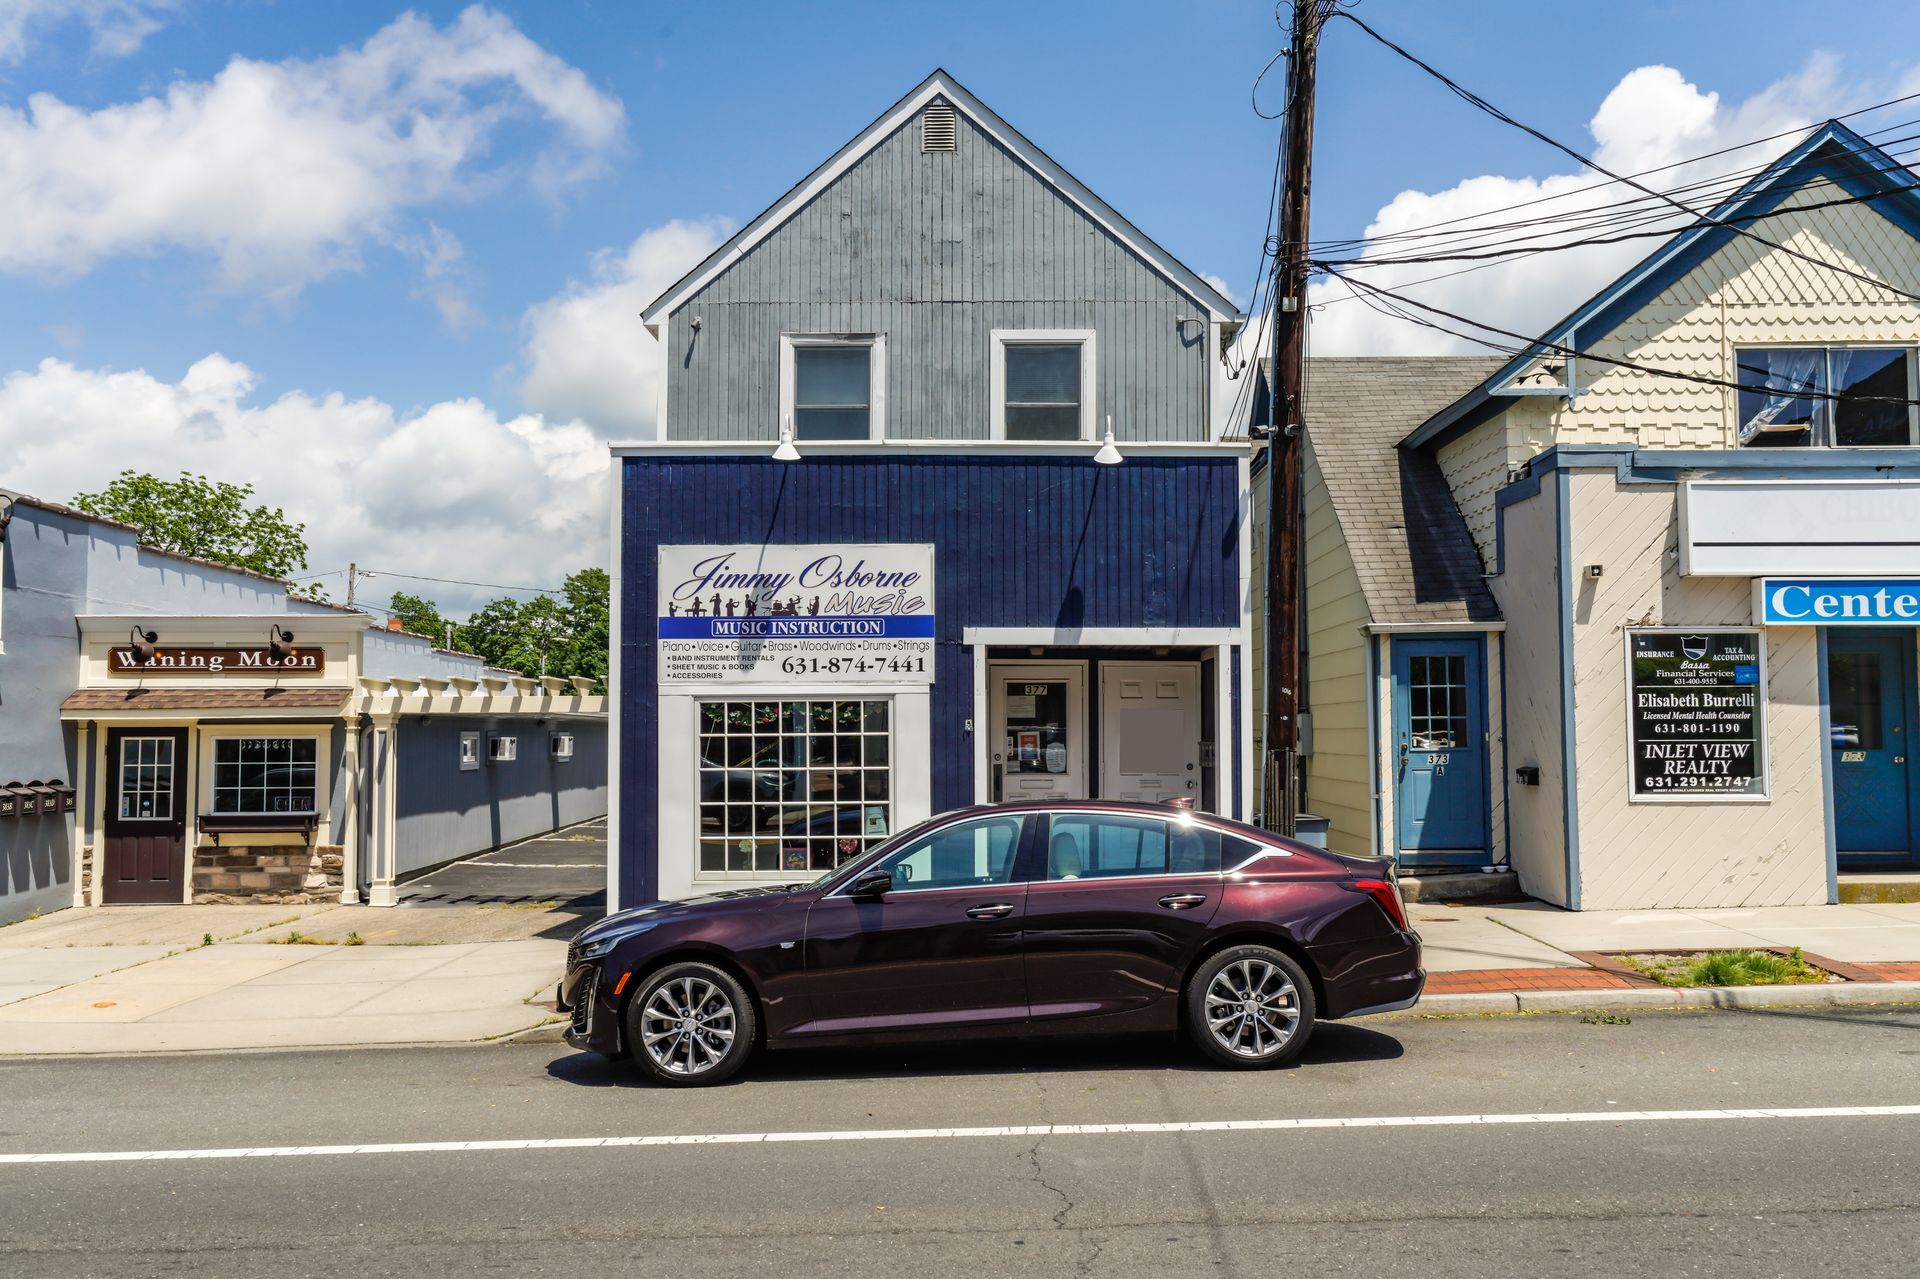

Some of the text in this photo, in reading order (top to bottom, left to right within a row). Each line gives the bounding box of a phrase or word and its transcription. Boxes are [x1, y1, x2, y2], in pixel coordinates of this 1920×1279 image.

[672, 552, 921, 601] Jimmy Osborne
[824, 589, 926, 616] Music
[715, 619, 883, 635] MUSIC INSTRUCTION
[662, 640, 930, 653] Piano Voice Guitar Brass Woodwinds Drums Strings
[781, 655, 926, 675] 631-874-7441
[1656, 669, 1696, 677] Financial
[1698, 669, 1735, 677] Services
[1026, 686, 1047, 694] 377
[1637, 693, 1755, 707] Elisabeth Burrelli
[1643, 711, 1751, 720] Licensed Mental Health Counselor
[1654, 723, 1740, 733] 631-801-1190
[1645, 743, 1750, 759] INLET VIEW
[1428, 755, 1448, 764] 373
[1664, 760, 1732, 775] REALTY
[1645, 776, 1752, 787] 631.291.2747
